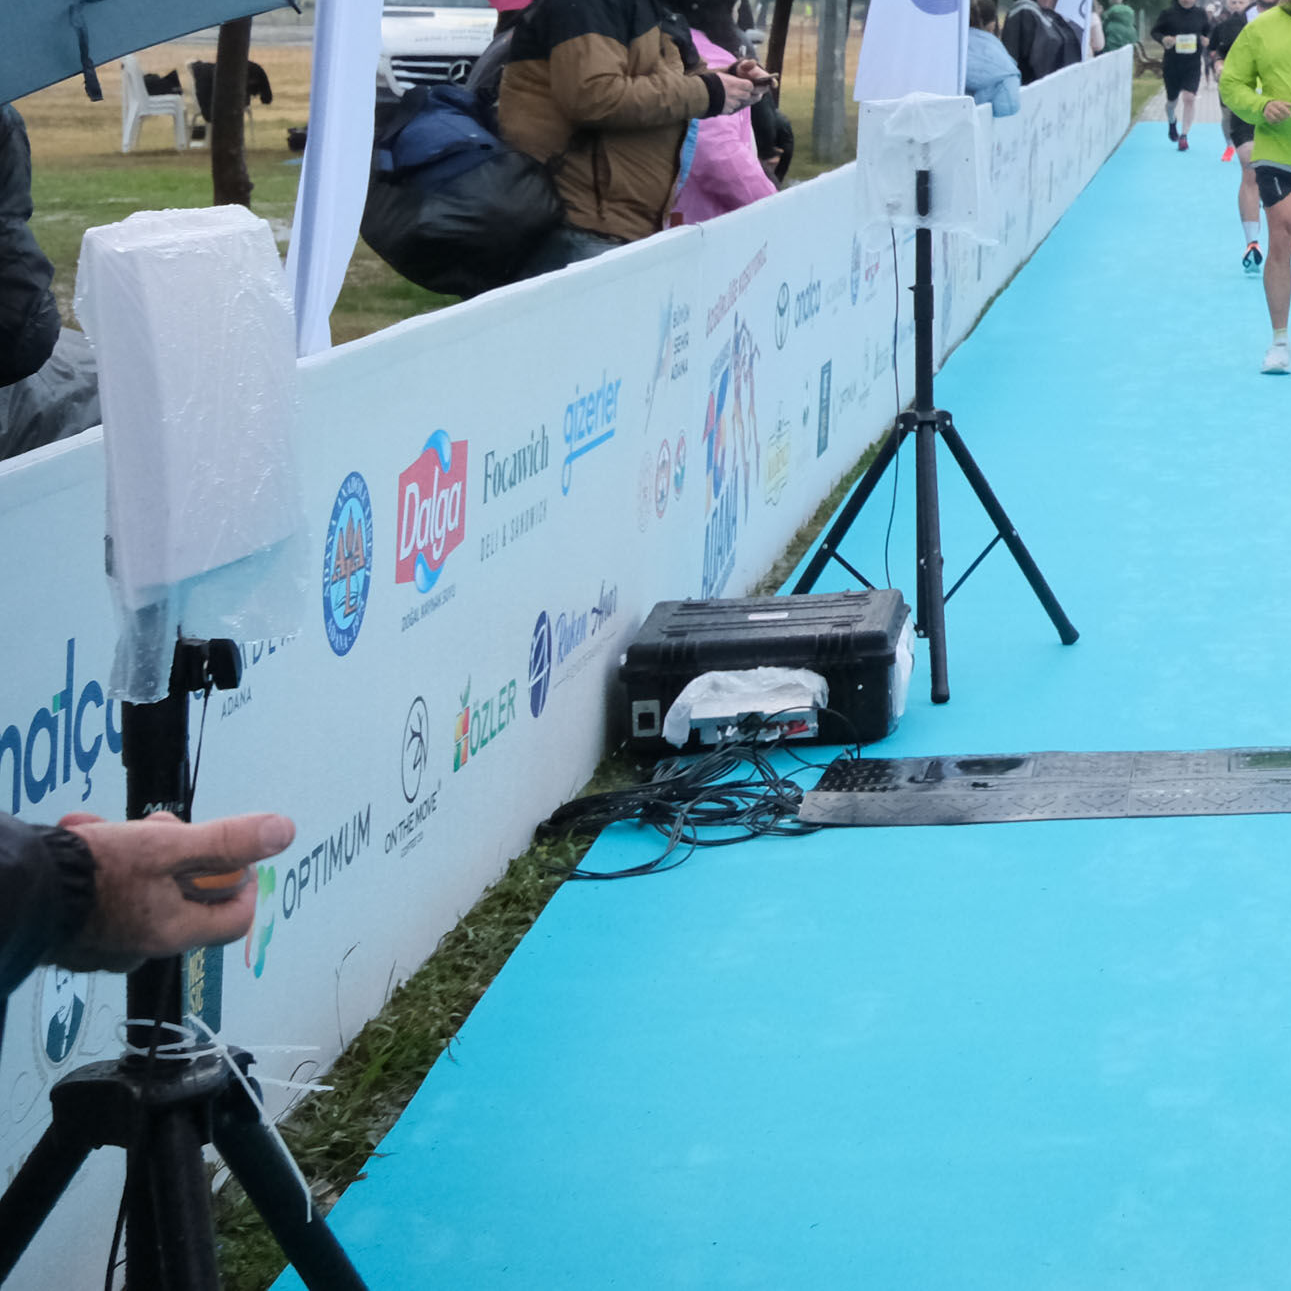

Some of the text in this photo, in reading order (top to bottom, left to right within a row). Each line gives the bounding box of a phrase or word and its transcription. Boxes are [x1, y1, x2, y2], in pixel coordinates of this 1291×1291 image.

[483, 424, 549, 504] Focawich
[562, 369, 621, 496] gizerler
[400, 466, 462, 561] Dalga
[221, 687, 252, 720] ADANA
[469, 677, 517, 757] ÖZLER
[283, 802, 372, 920] OPTIMUM
